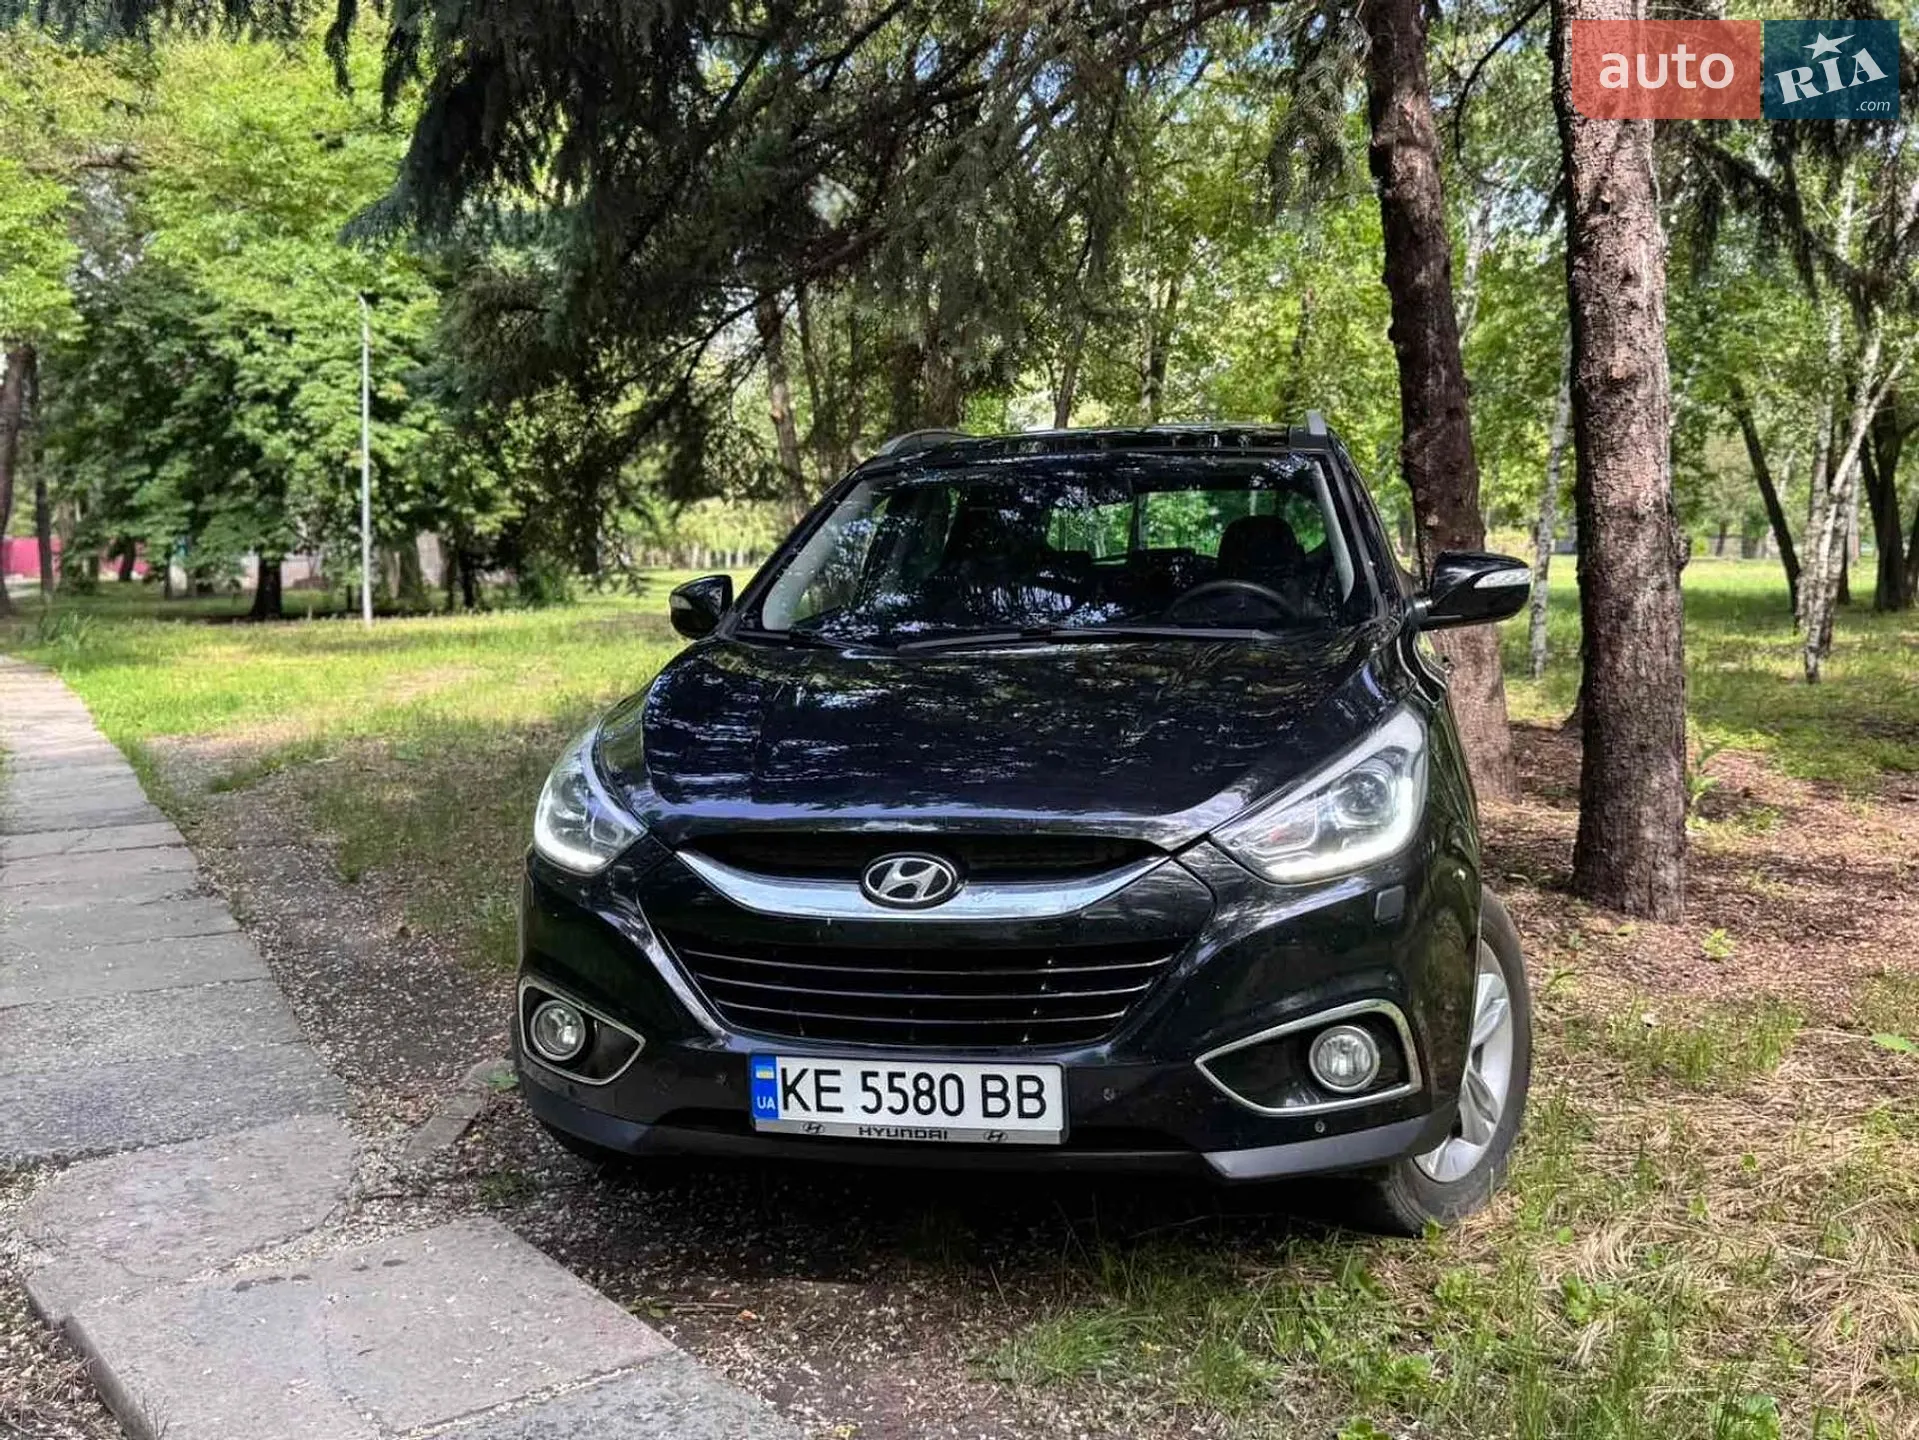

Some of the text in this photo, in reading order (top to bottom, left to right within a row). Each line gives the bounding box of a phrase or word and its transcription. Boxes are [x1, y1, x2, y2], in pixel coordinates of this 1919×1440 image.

[780, 1066, 1047, 1120] KE 5580 BB
[756, 1095, 776, 1110] UA
[858, 1126, 948, 1141] HYUNDAI
